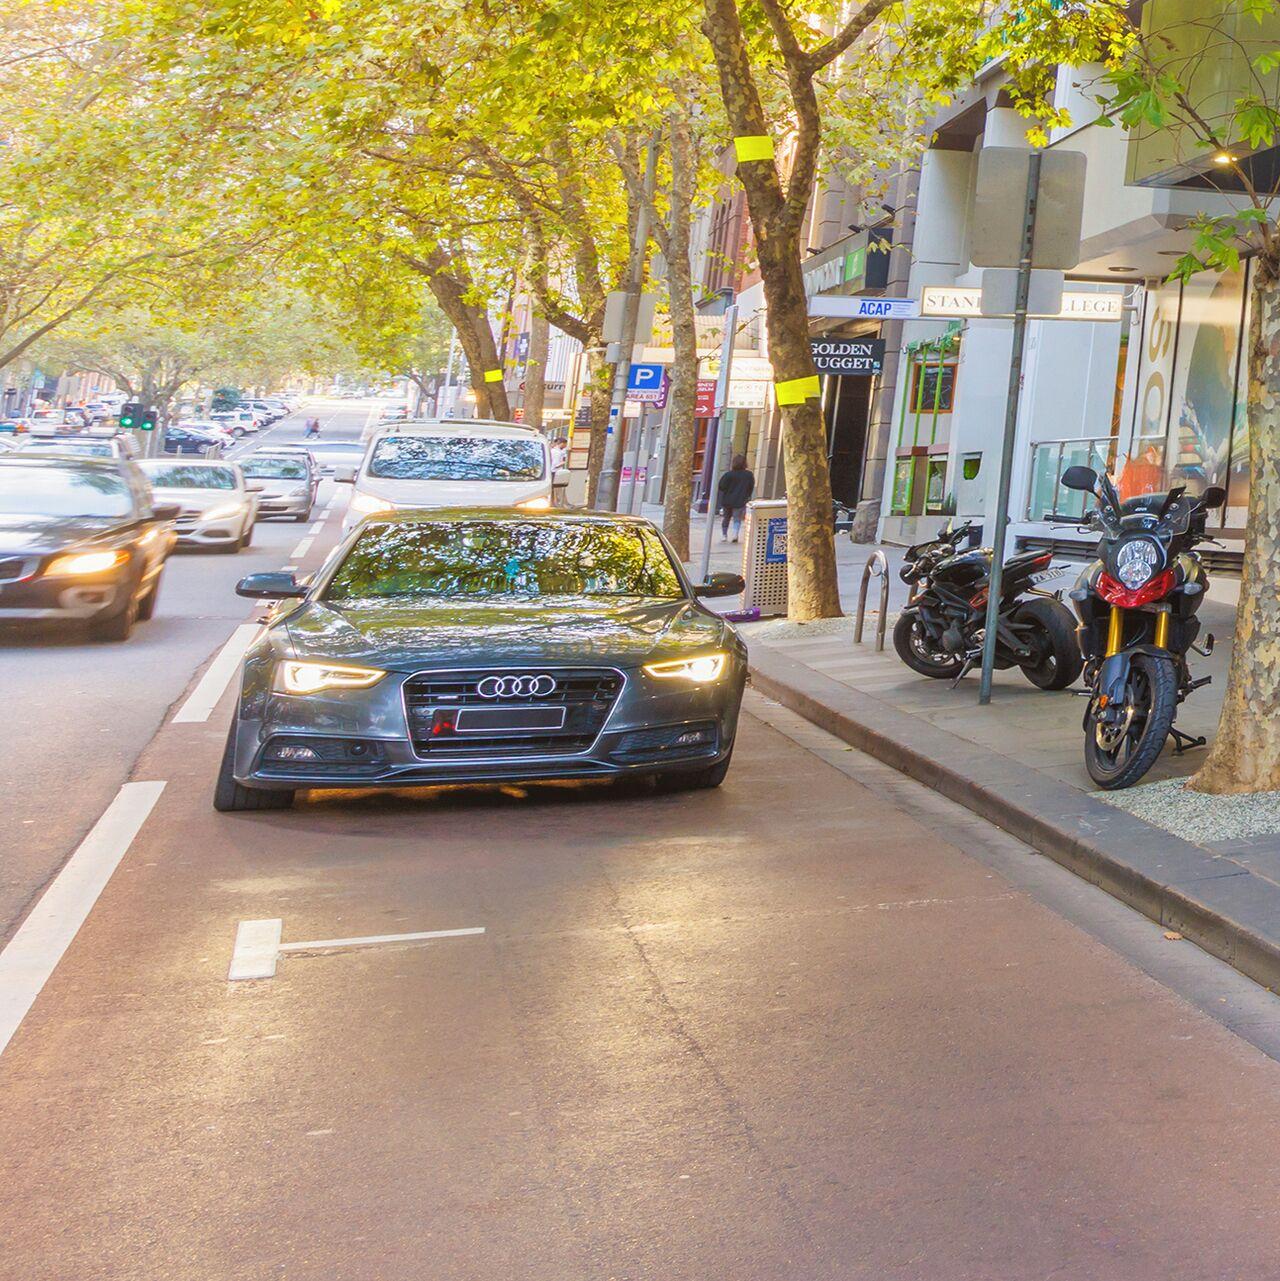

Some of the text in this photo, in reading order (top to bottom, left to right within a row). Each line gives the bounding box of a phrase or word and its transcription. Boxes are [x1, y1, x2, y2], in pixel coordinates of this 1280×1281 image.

[858, 302, 892, 315] ACAP
[1065, 299, 1118, 313] LEGE
[635, 368, 654, 386] P
